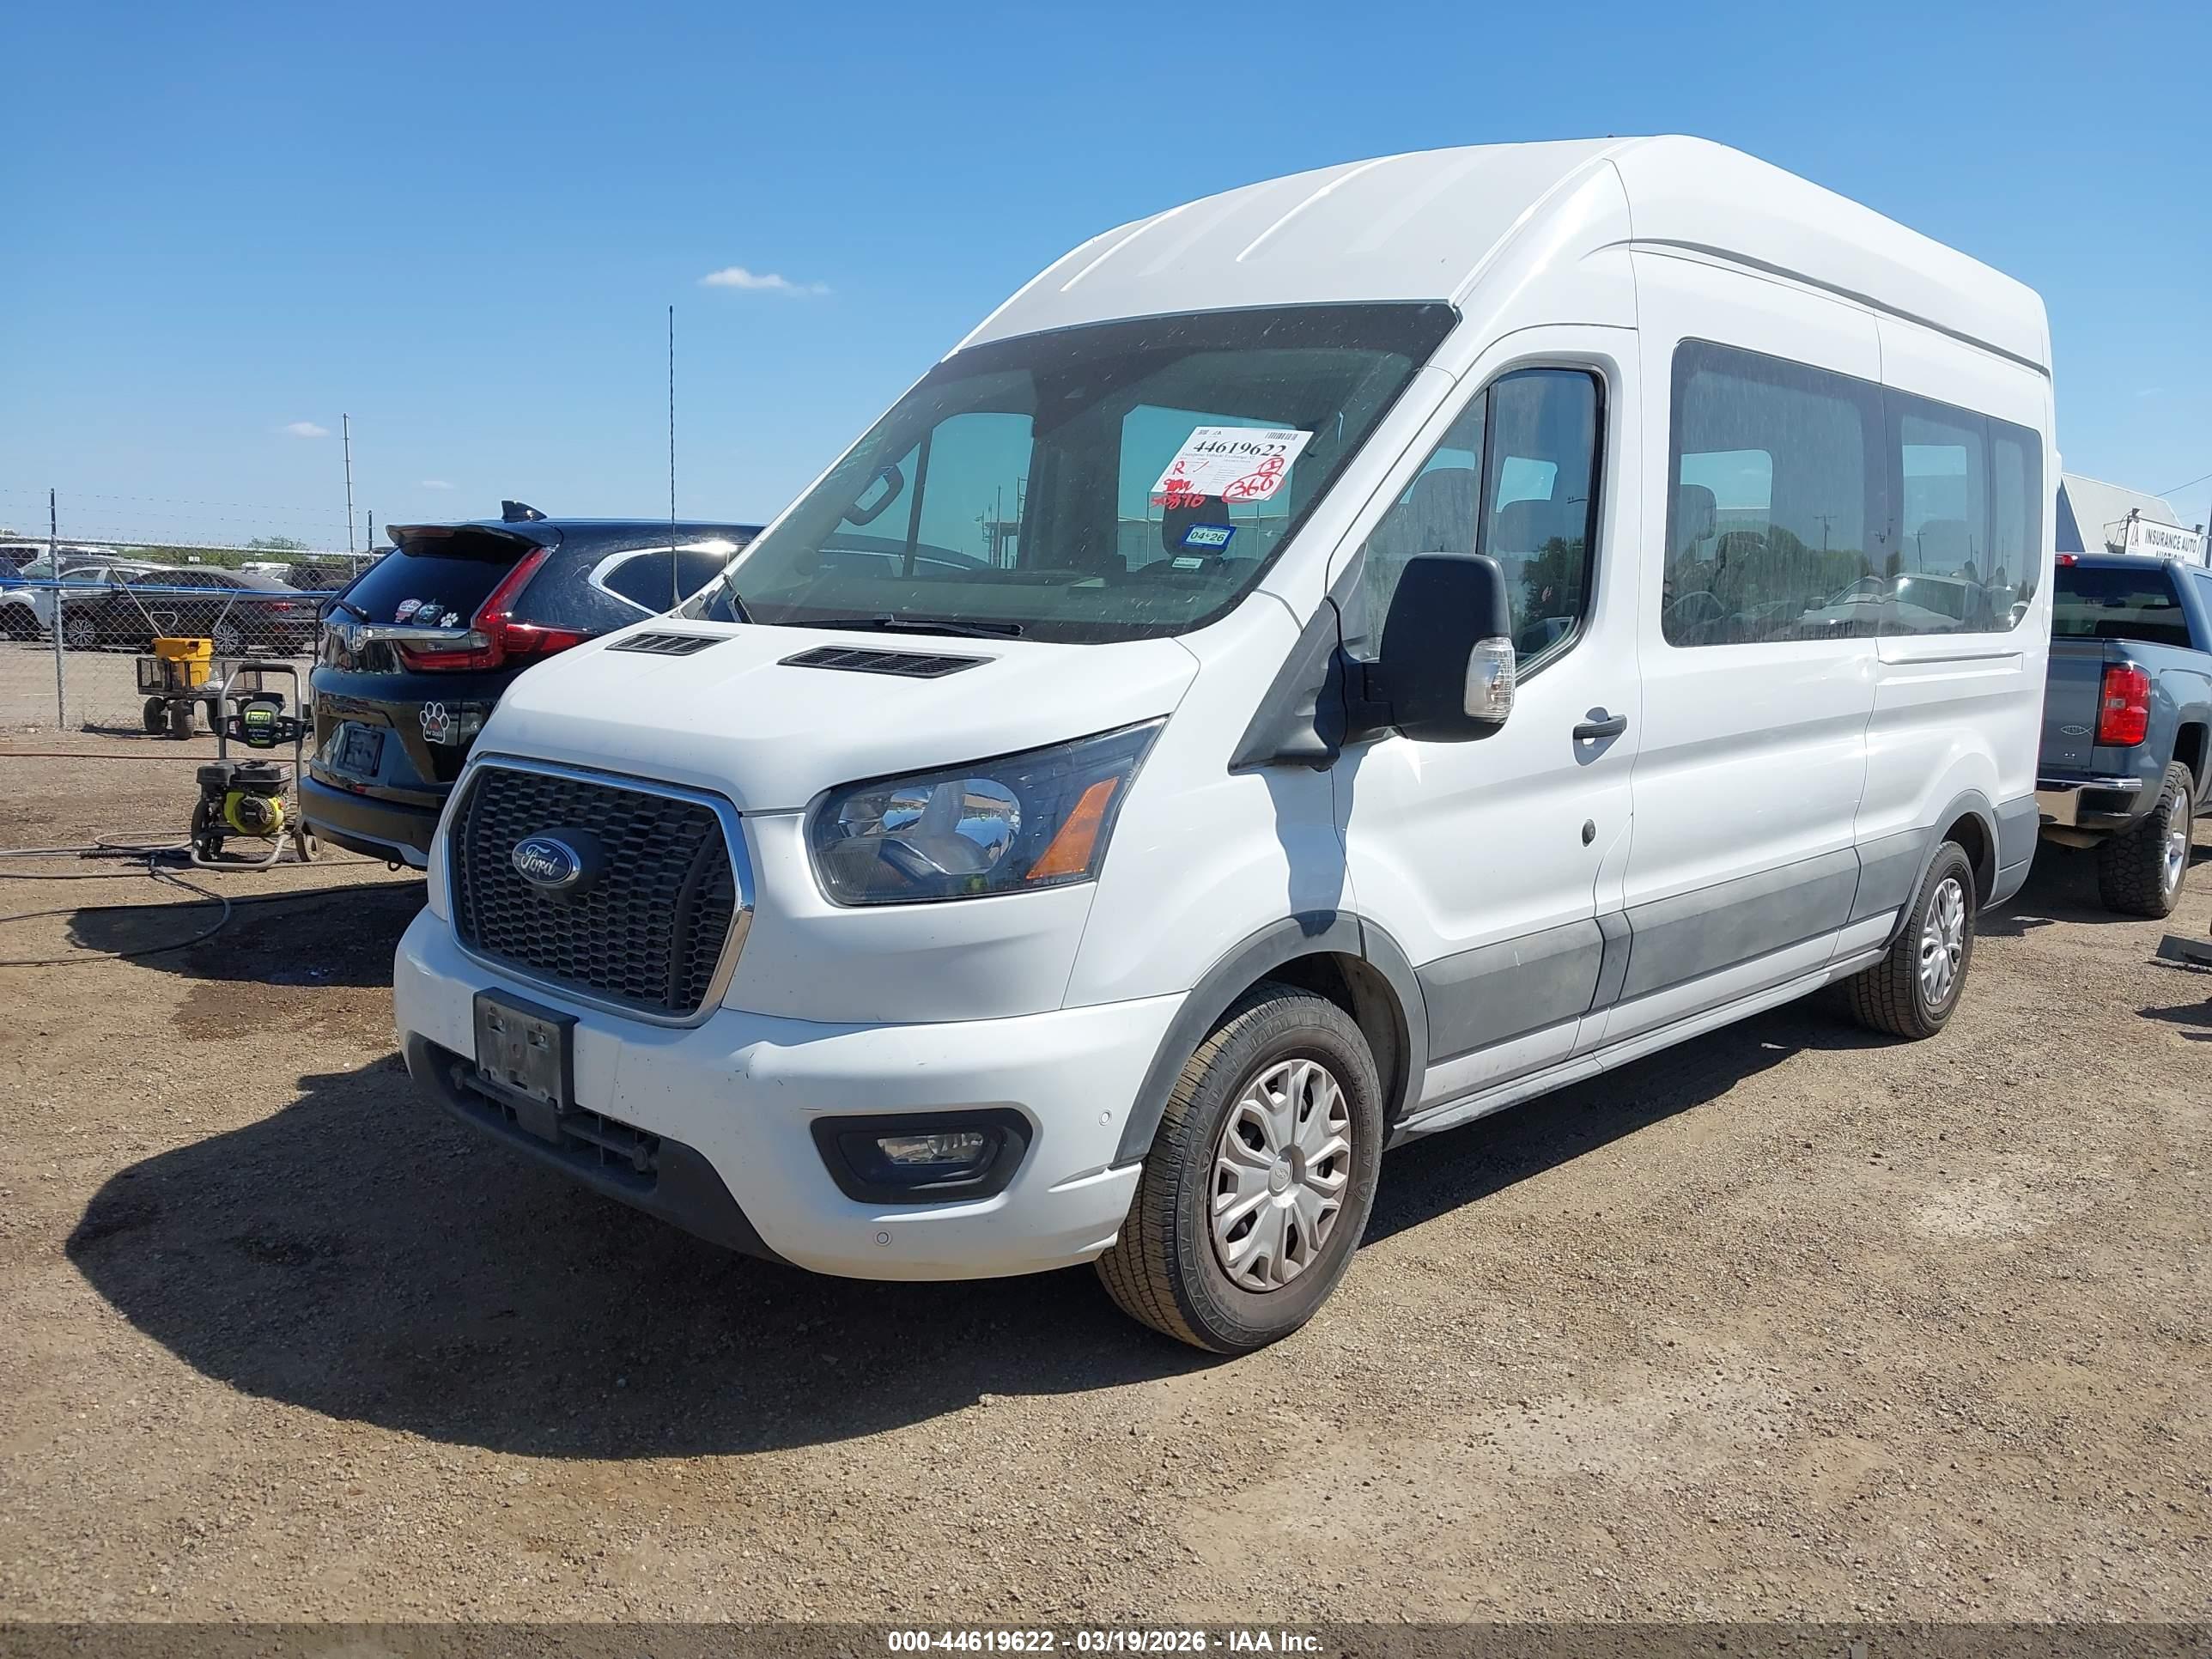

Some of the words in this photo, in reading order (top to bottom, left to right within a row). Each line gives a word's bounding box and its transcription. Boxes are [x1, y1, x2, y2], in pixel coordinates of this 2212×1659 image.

[1193, 440, 1287, 458] 44619622
[1190, 532, 1205, 540] 04
[1208, 532, 1226, 542] 26
[2145, 528, 2181, 550] INSURANCE
[2181, 536, 2197, 554] AUTO
[520, 843, 558, 877] Ford
